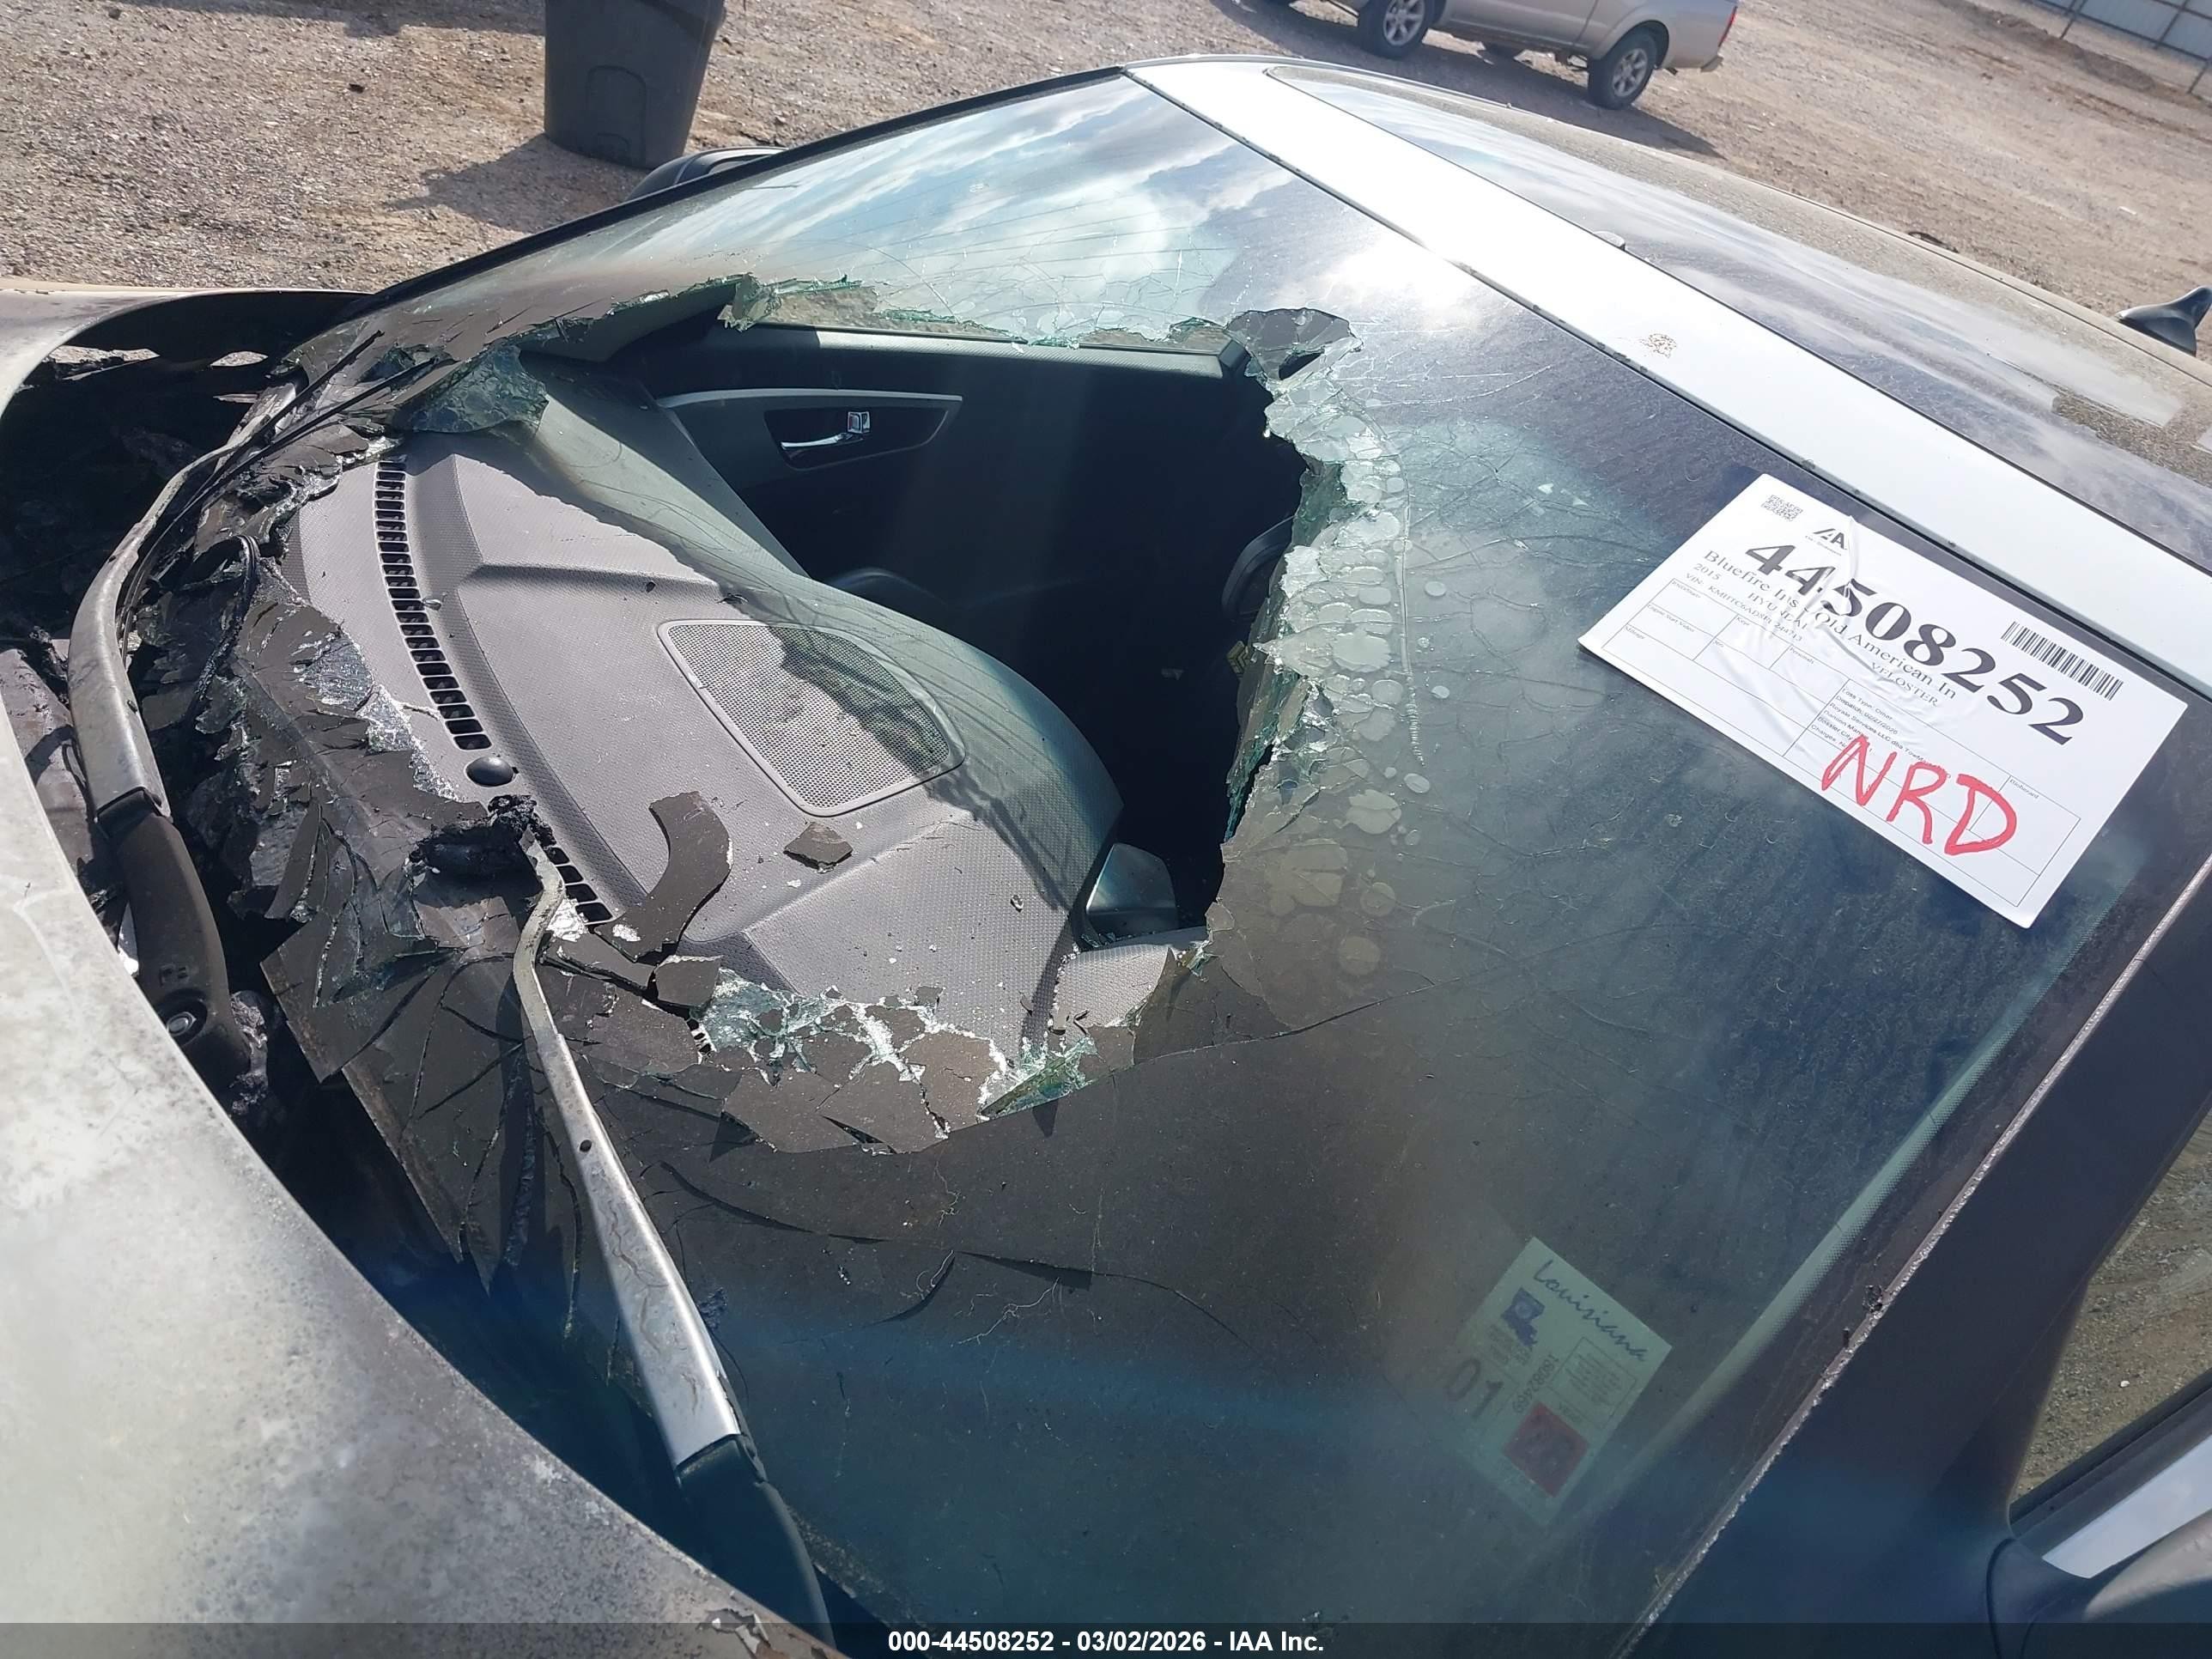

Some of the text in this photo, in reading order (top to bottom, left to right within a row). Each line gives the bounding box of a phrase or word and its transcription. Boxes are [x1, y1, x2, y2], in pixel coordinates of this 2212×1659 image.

[1693, 563, 1938, 708] 2015 HYUNDAI VELOSTER
[1704, 550, 1771, 592] Bluefire
[1815, 612, 1848, 635] Old
[1848, 634, 1933, 685] American
[1938, 682, 1956, 699] In
[1745, 544, 2085, 745] 44508252
[1821, 733, 2016, 856] NRD
[1533, 1259, 1648, 1363] Louisiana
[1446, 1358, 1503, 1418] 01
